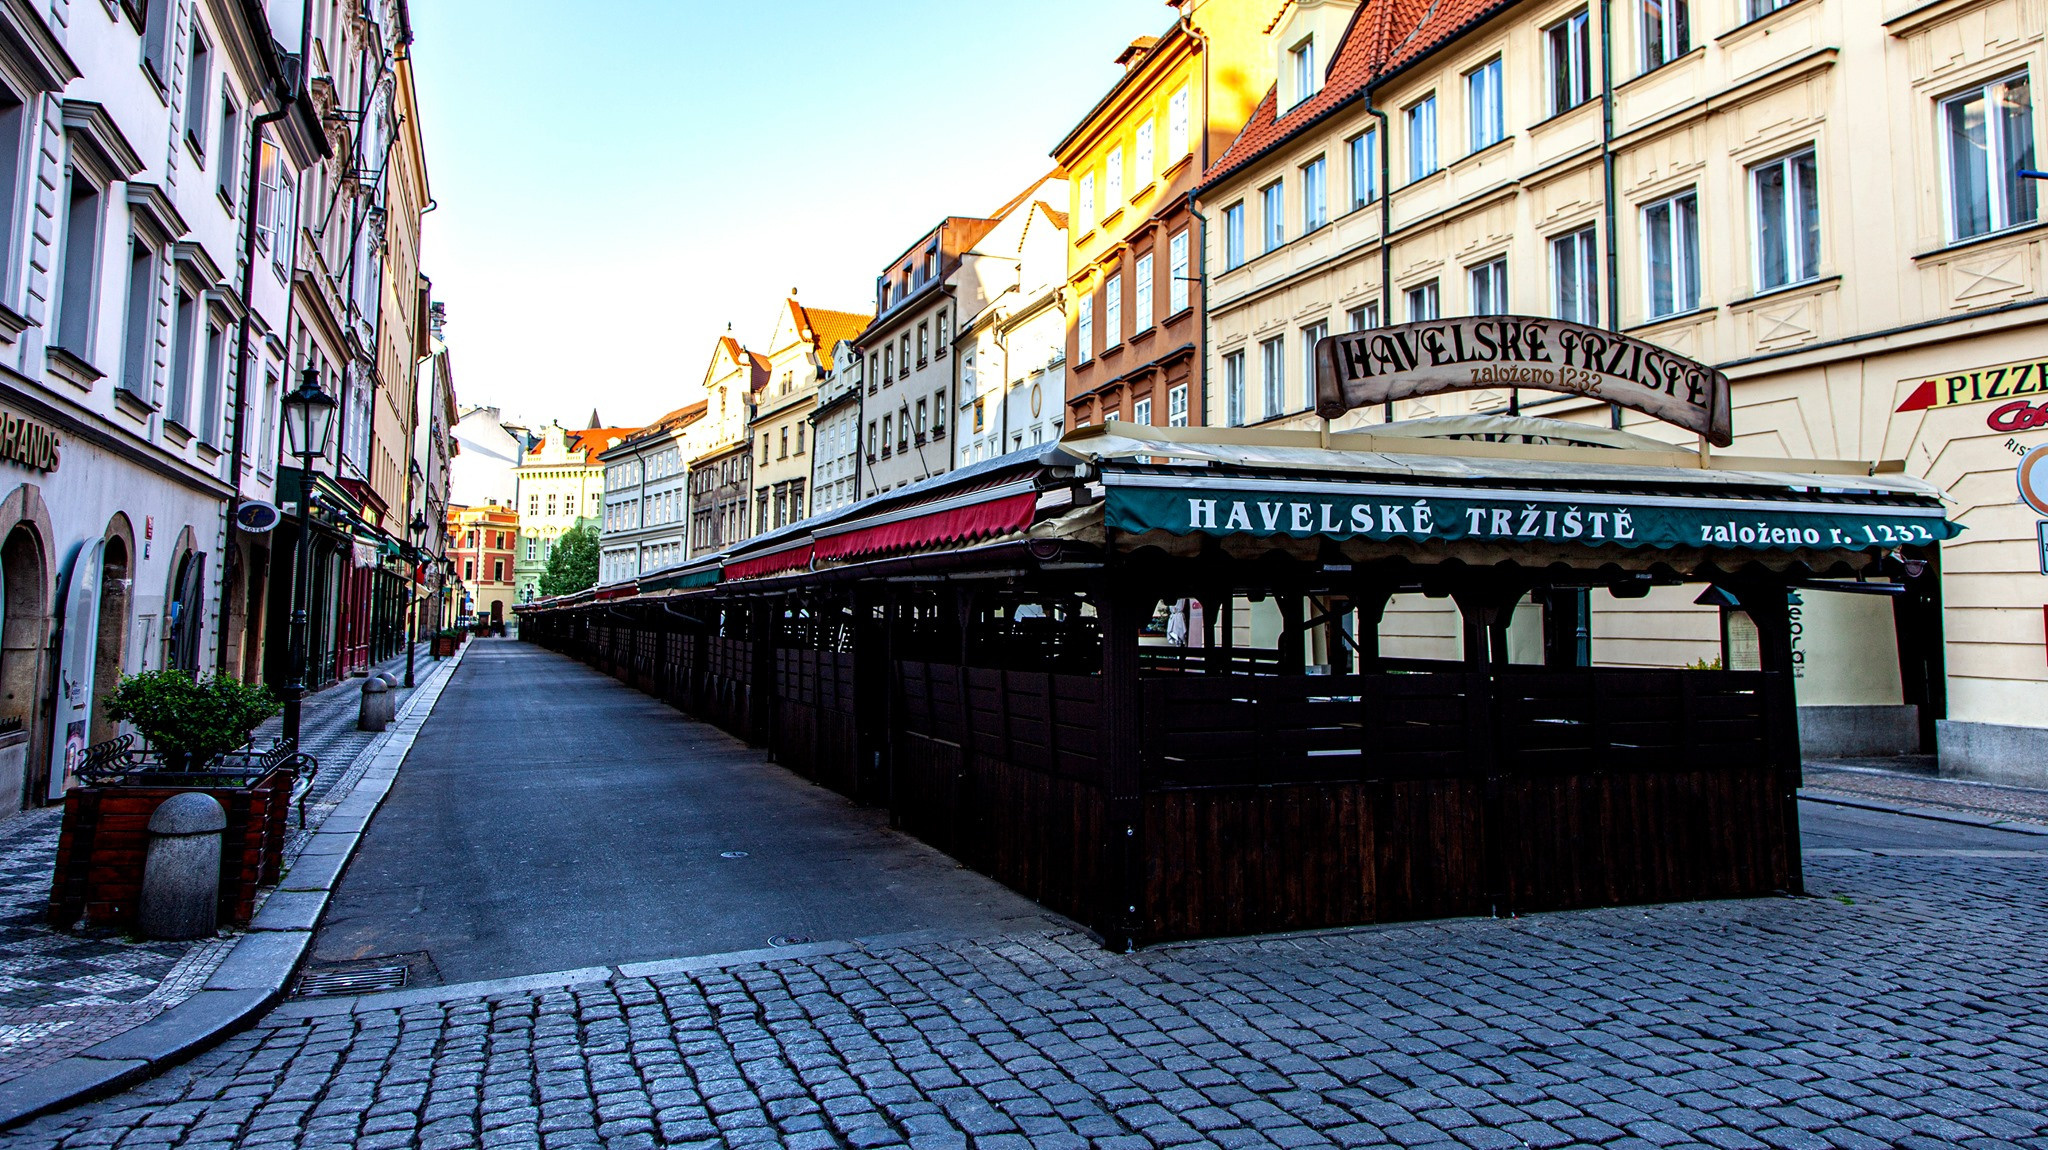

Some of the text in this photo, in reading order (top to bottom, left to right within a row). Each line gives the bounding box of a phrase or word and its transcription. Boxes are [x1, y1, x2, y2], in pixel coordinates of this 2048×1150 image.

[1342, 319, 1711, 410] HAVELSKÉ TRŽIŠTĚ
[1470, 364, 1603, 394] založeno 1232
[2004, 437, 2031, 457] RIS
[1188, 498, 1933, 544] HAVELSKÉ TRŽIŠTĚ založeno r. 1232
[1788, 592, 1804, 664] eora
